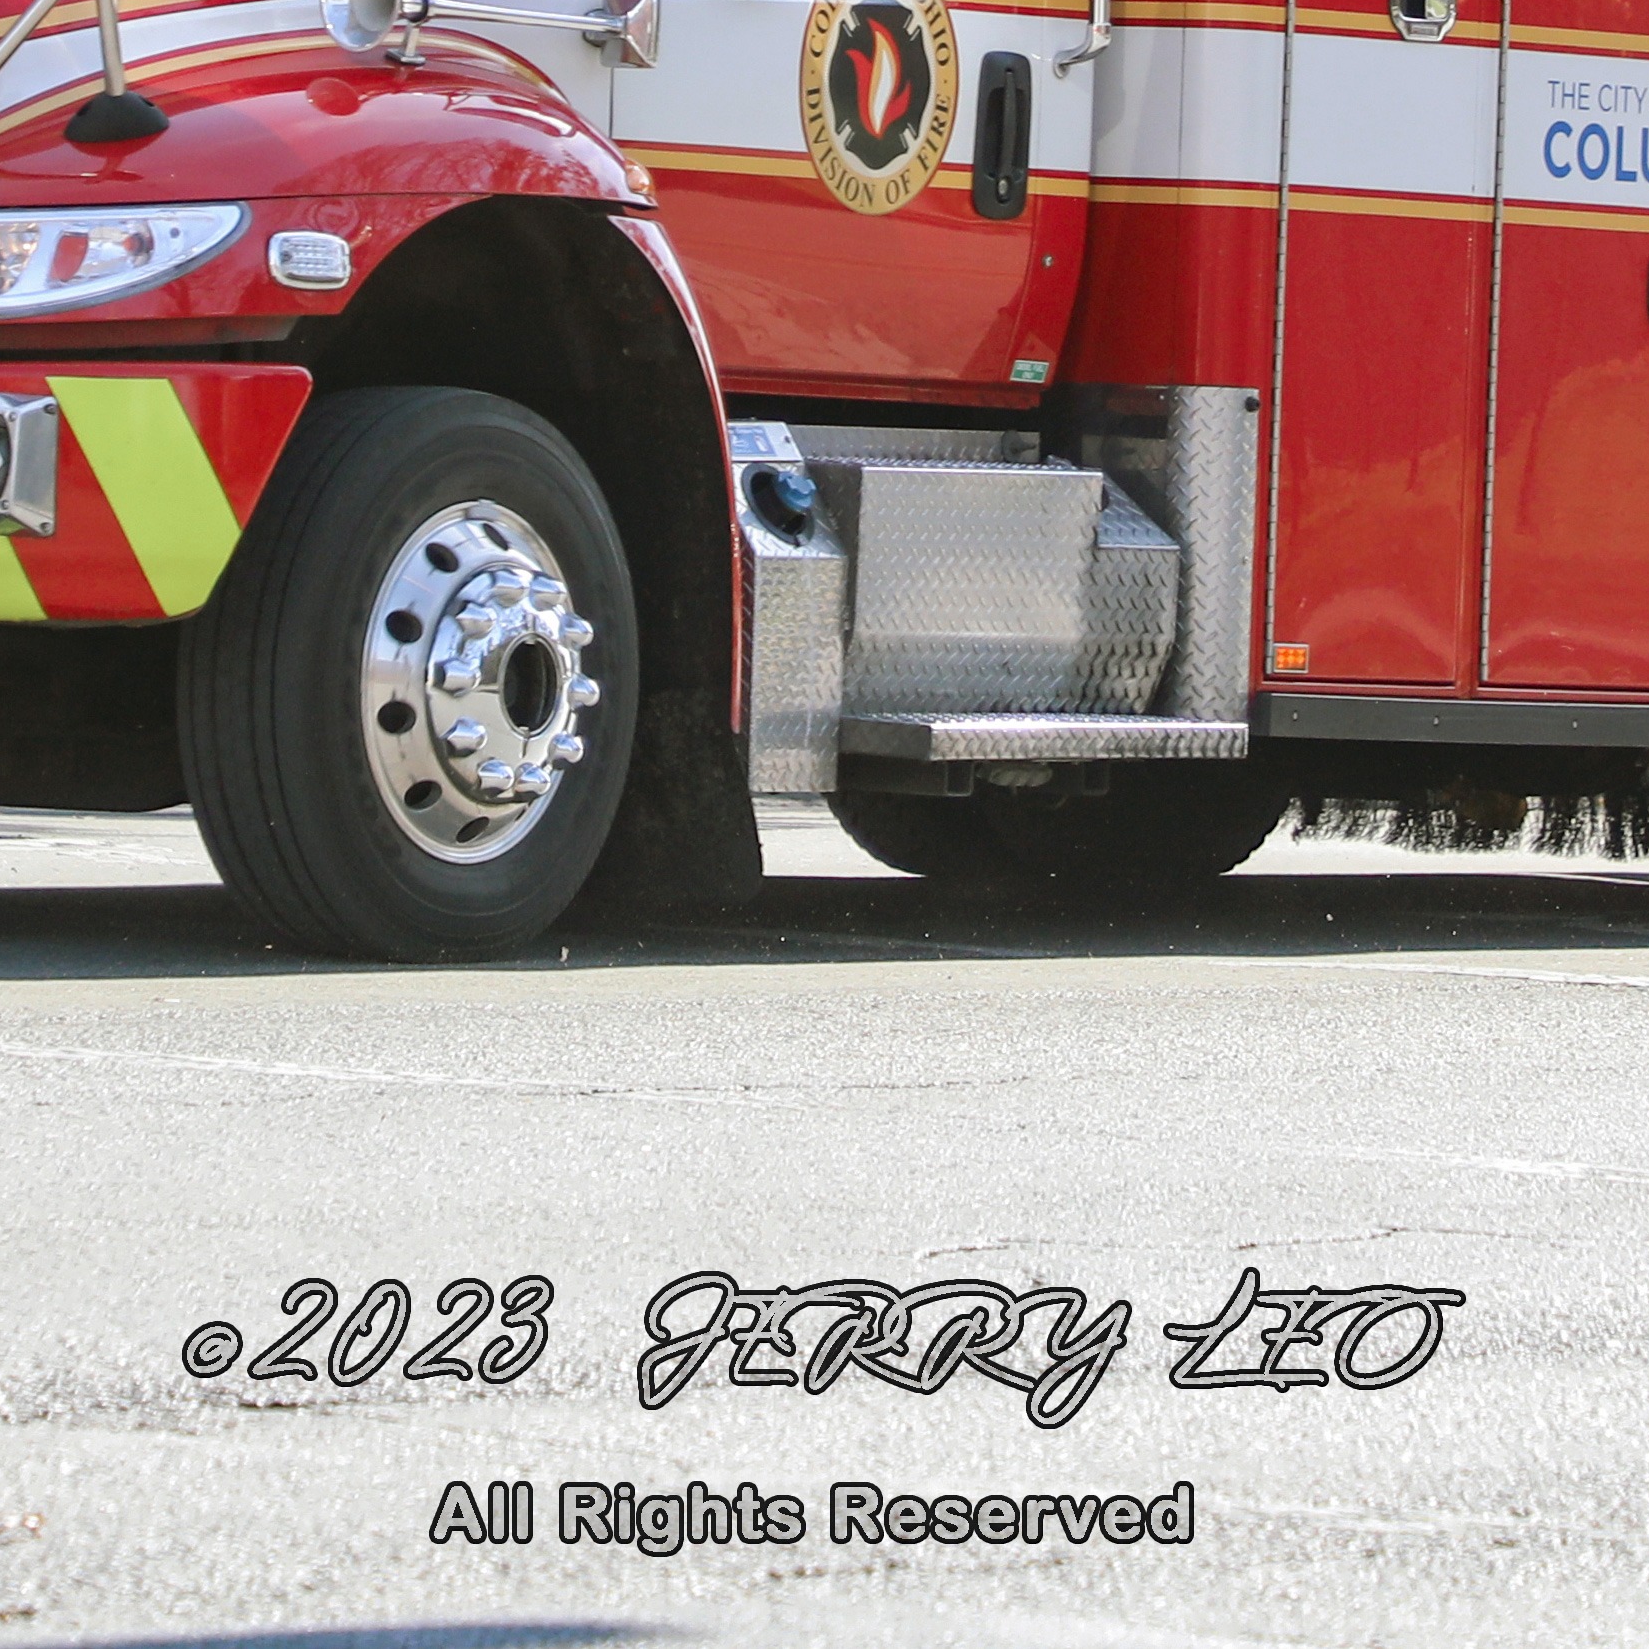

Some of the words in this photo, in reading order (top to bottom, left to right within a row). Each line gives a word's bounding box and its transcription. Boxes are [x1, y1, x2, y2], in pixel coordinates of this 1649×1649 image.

[1547, 80, 1590, 111] THE
[1597, 84, 1648, 114] CITY
[806, 88, 876, 208] DIVISION
[885, 168, 913, 205] OF
[916, 94, 951, 172] FIRE
